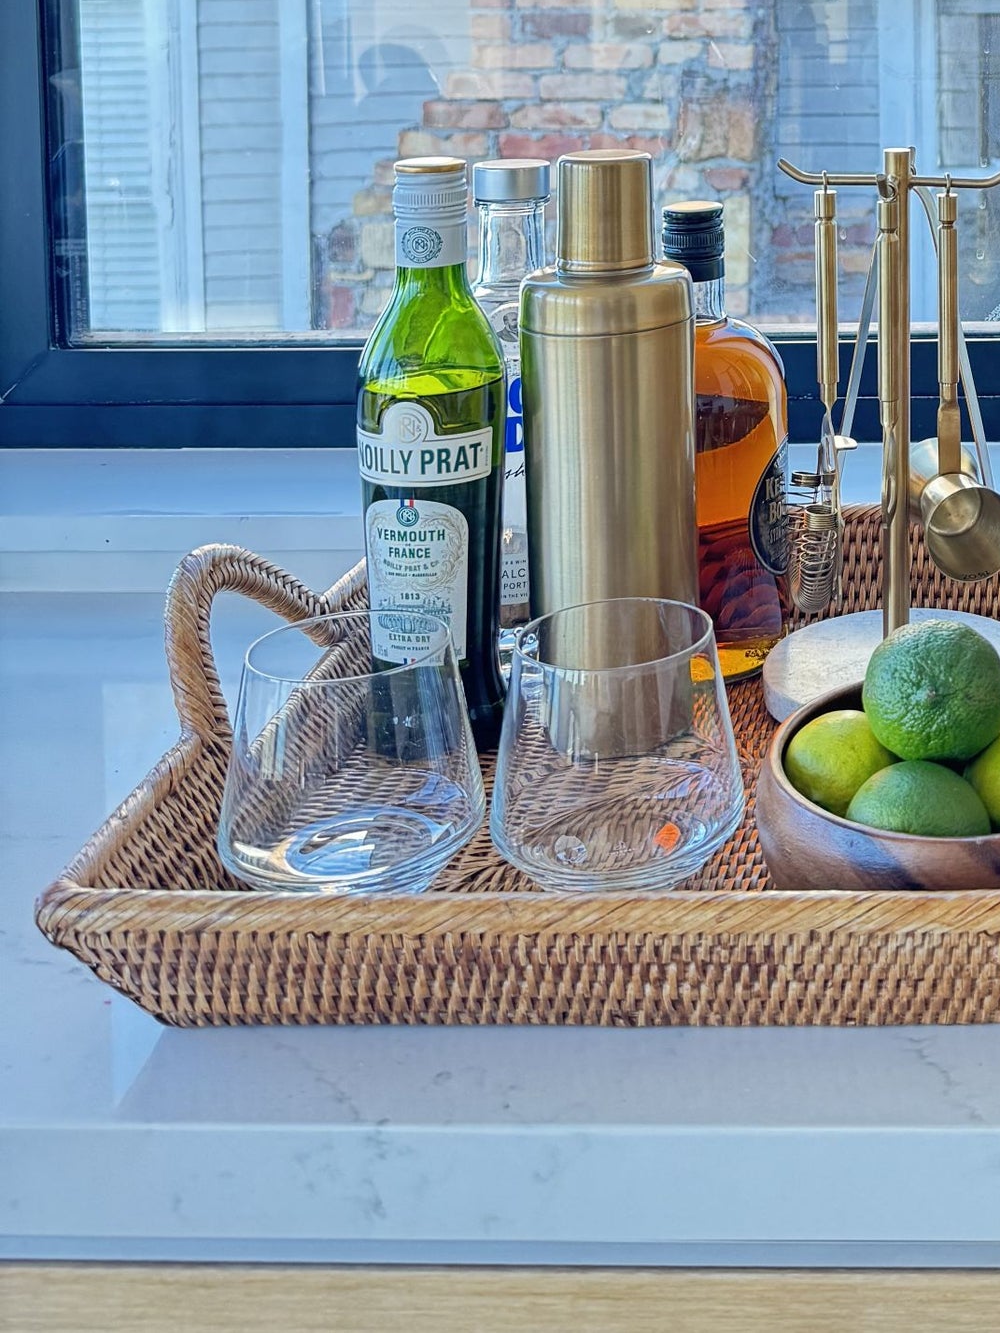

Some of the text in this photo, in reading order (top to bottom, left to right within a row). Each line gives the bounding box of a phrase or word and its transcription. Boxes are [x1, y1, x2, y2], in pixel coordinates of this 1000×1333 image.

[359, 439, 413, 475] NOILLY
[420, 442, 482, 475] PRAT
[376, 527, 446, 542] VERMOUTH
[388, 546, 431, 559] FRANCE
[502, 568, 526, 579] ALC
[400, 592, 420, 601] 1813
[388, 632, 430, 643] EXTRA DRY
